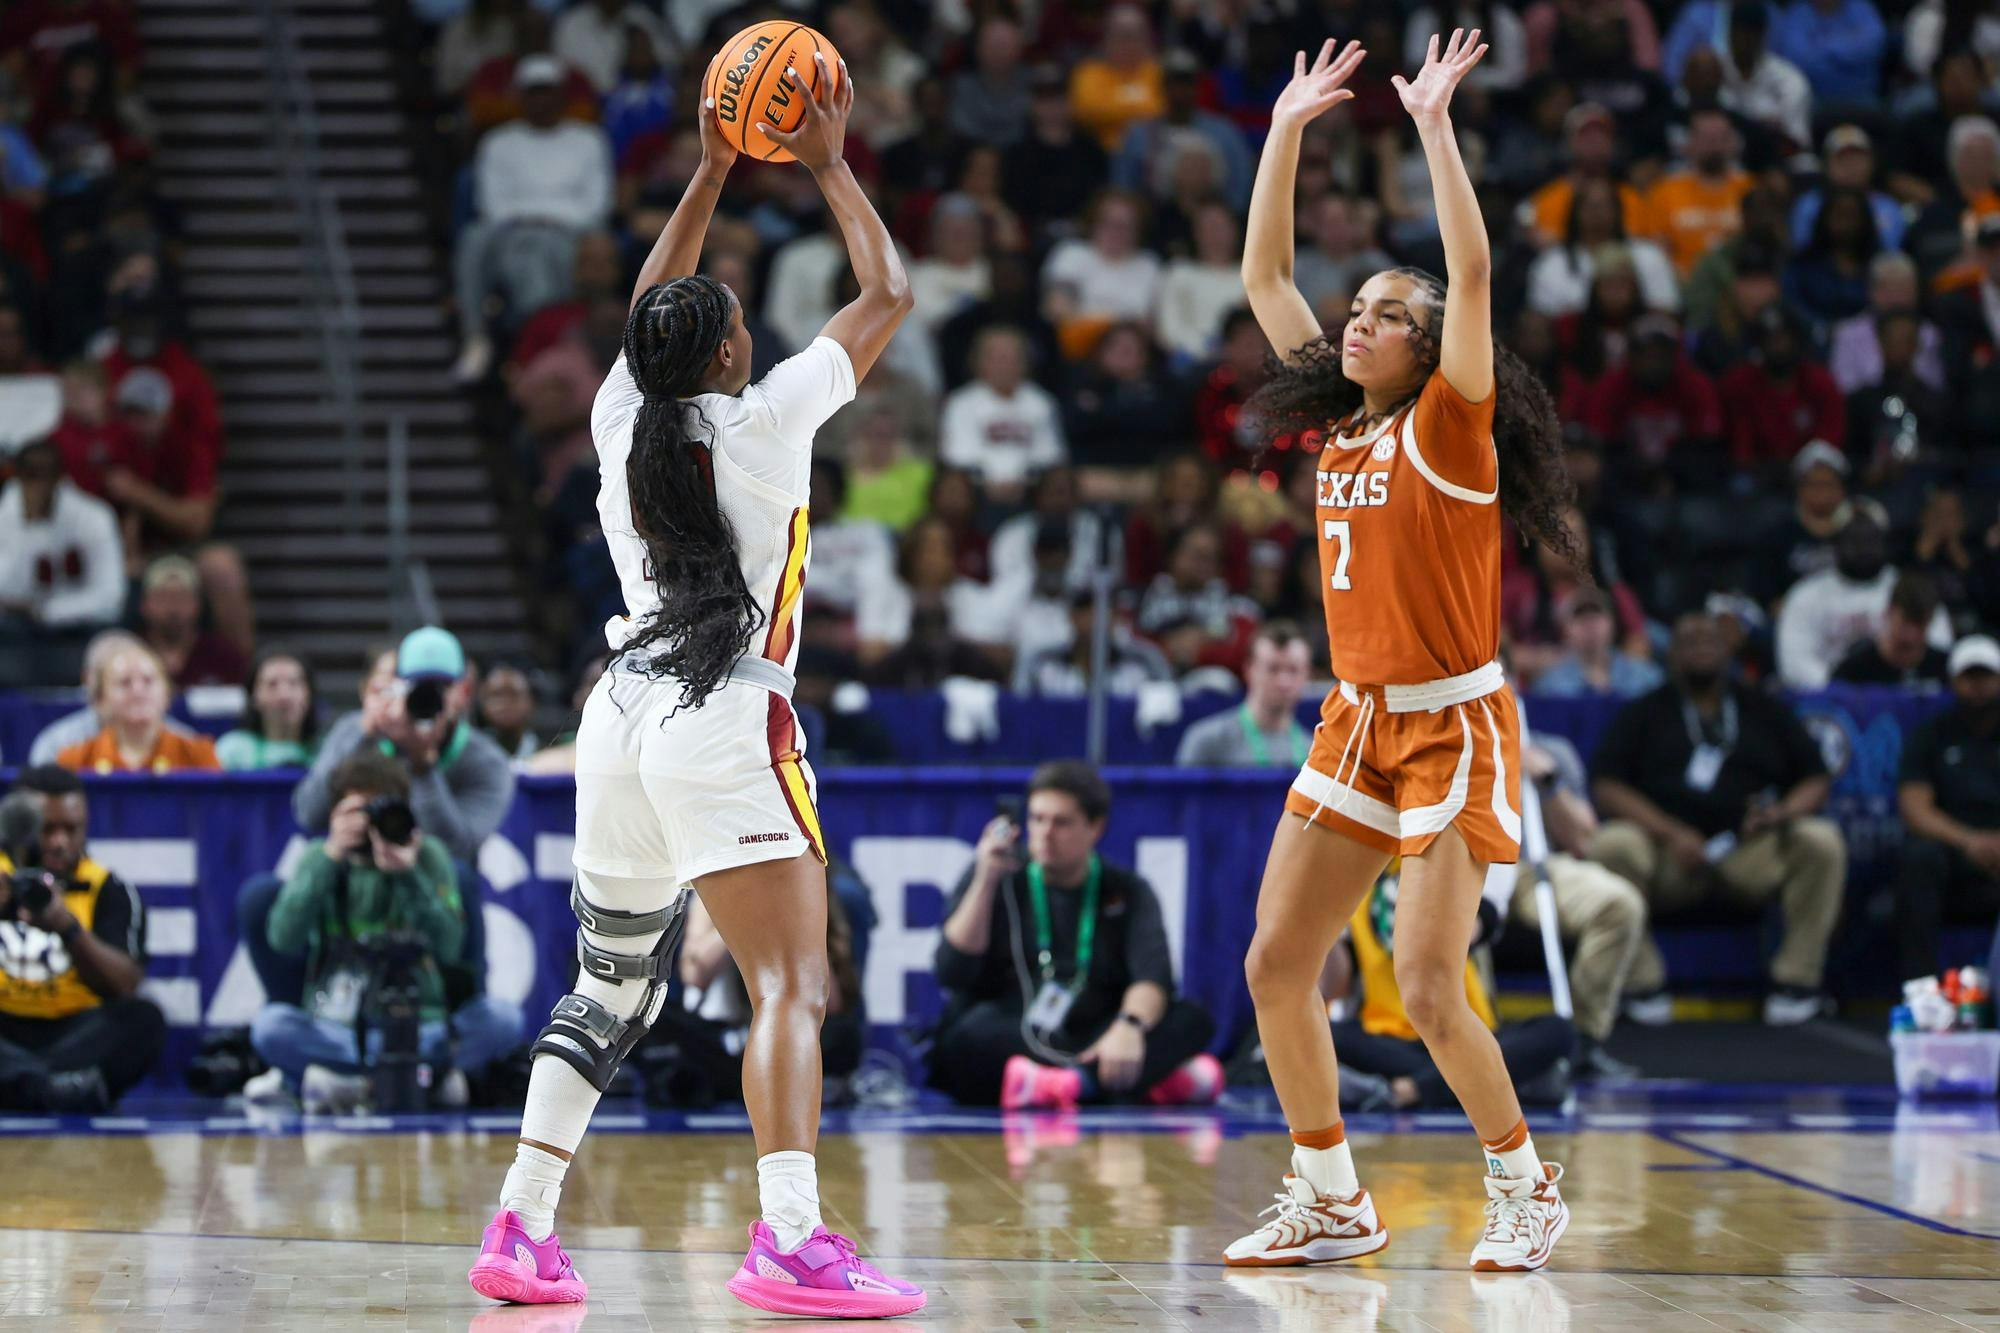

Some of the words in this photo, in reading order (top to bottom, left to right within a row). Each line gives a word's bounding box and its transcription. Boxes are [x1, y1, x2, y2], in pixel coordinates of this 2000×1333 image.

[719, 35, 774, 123] Wilson
[1316, 470, 1389, 508] EXAS
[1324, 519, 1351, 590] 7
[738, 832, 790, 845] GAMECOCKS
